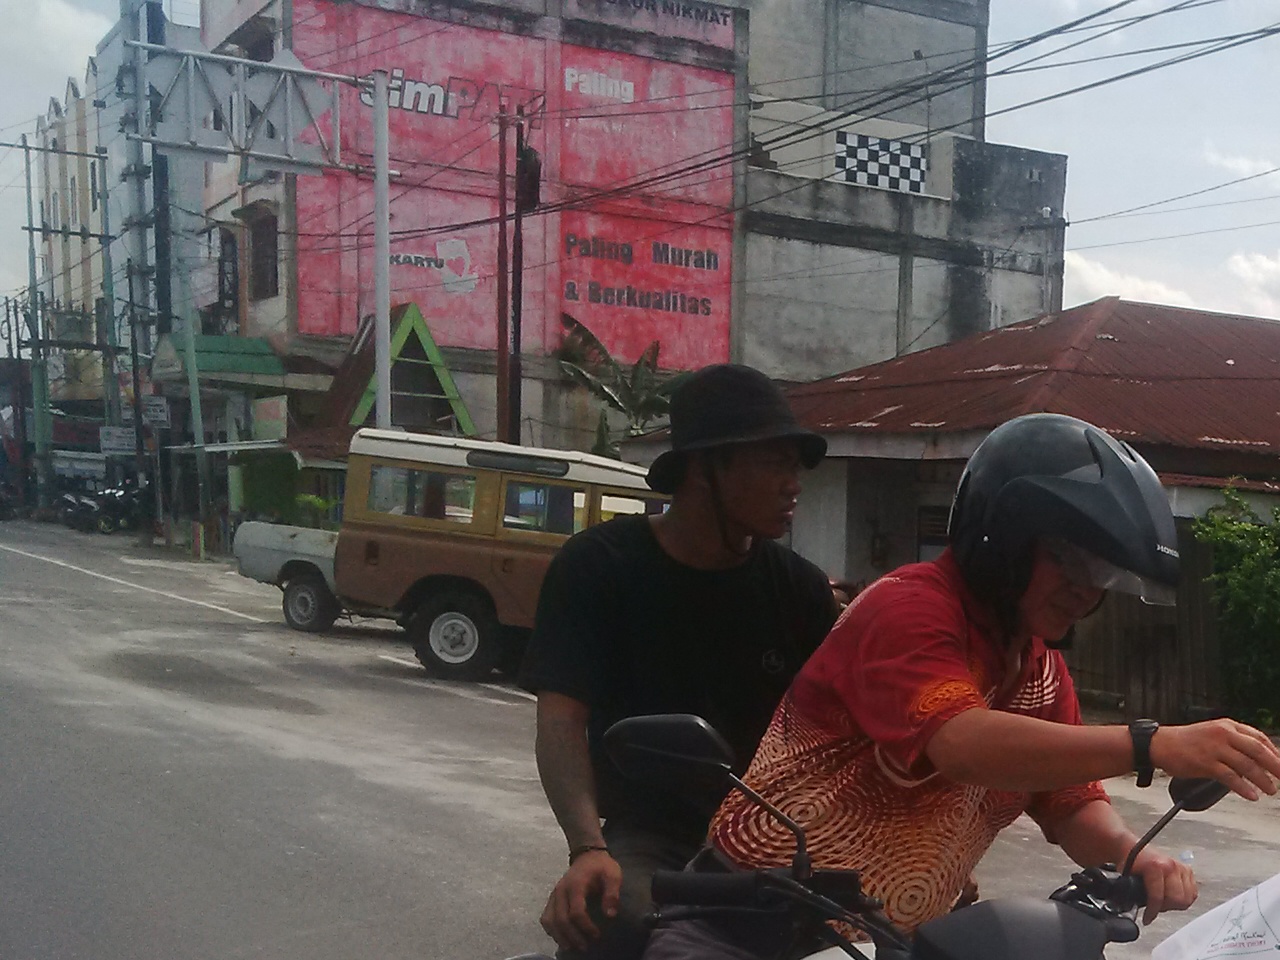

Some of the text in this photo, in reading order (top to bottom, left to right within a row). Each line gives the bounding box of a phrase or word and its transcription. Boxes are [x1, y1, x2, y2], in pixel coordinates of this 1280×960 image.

[564, 67, 635, 104] Paling
[389, 254, 445, 269] KARTU
[566, 233, 719, 271] Paling Murah
[588, 281, 712, 316] Berkualitas
